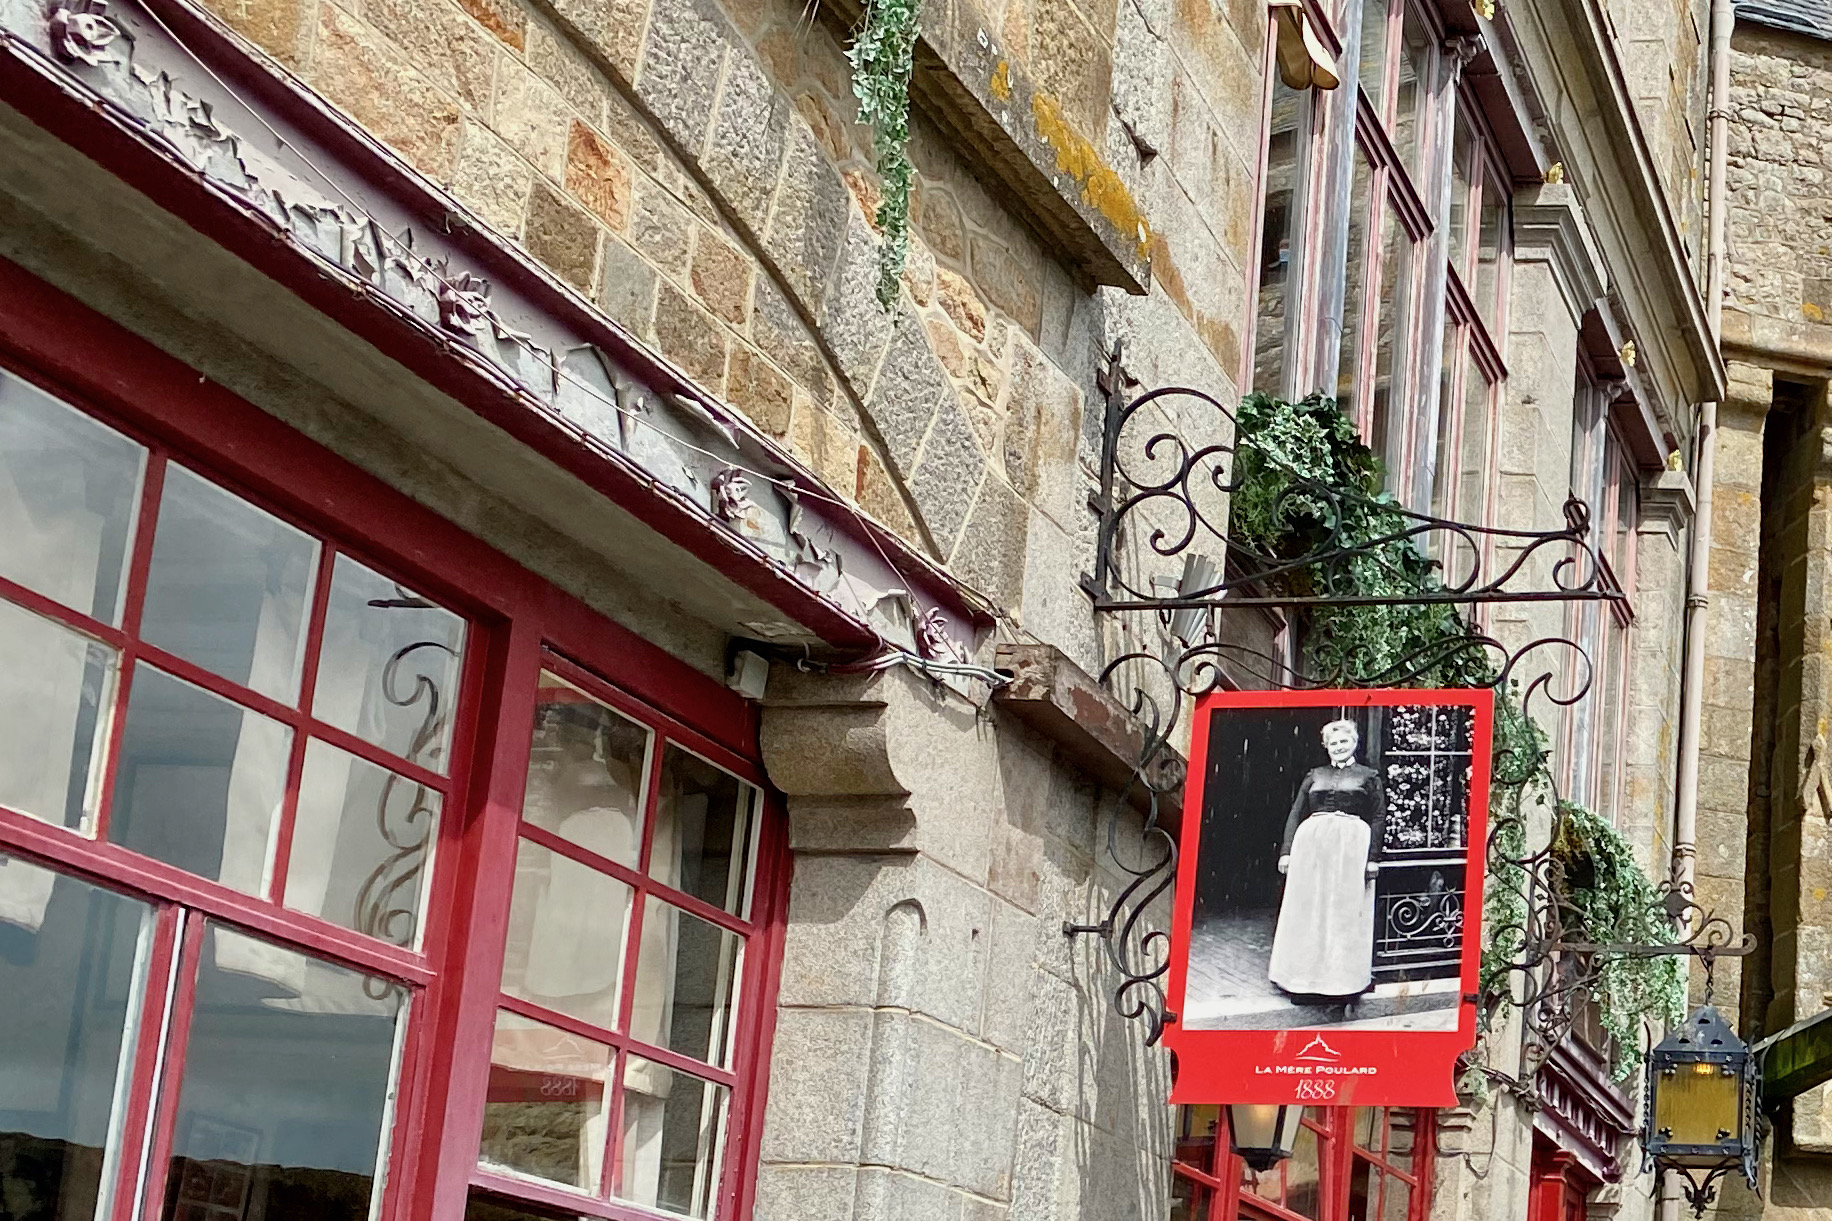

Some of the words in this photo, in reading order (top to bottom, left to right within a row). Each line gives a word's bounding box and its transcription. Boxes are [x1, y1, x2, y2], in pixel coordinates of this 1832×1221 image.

[1255, 1065, 1272, 1074] LA
[1316, 1065, 1377, 1075] POULARD
[1294, 1079, 1336, 1099] 1888
